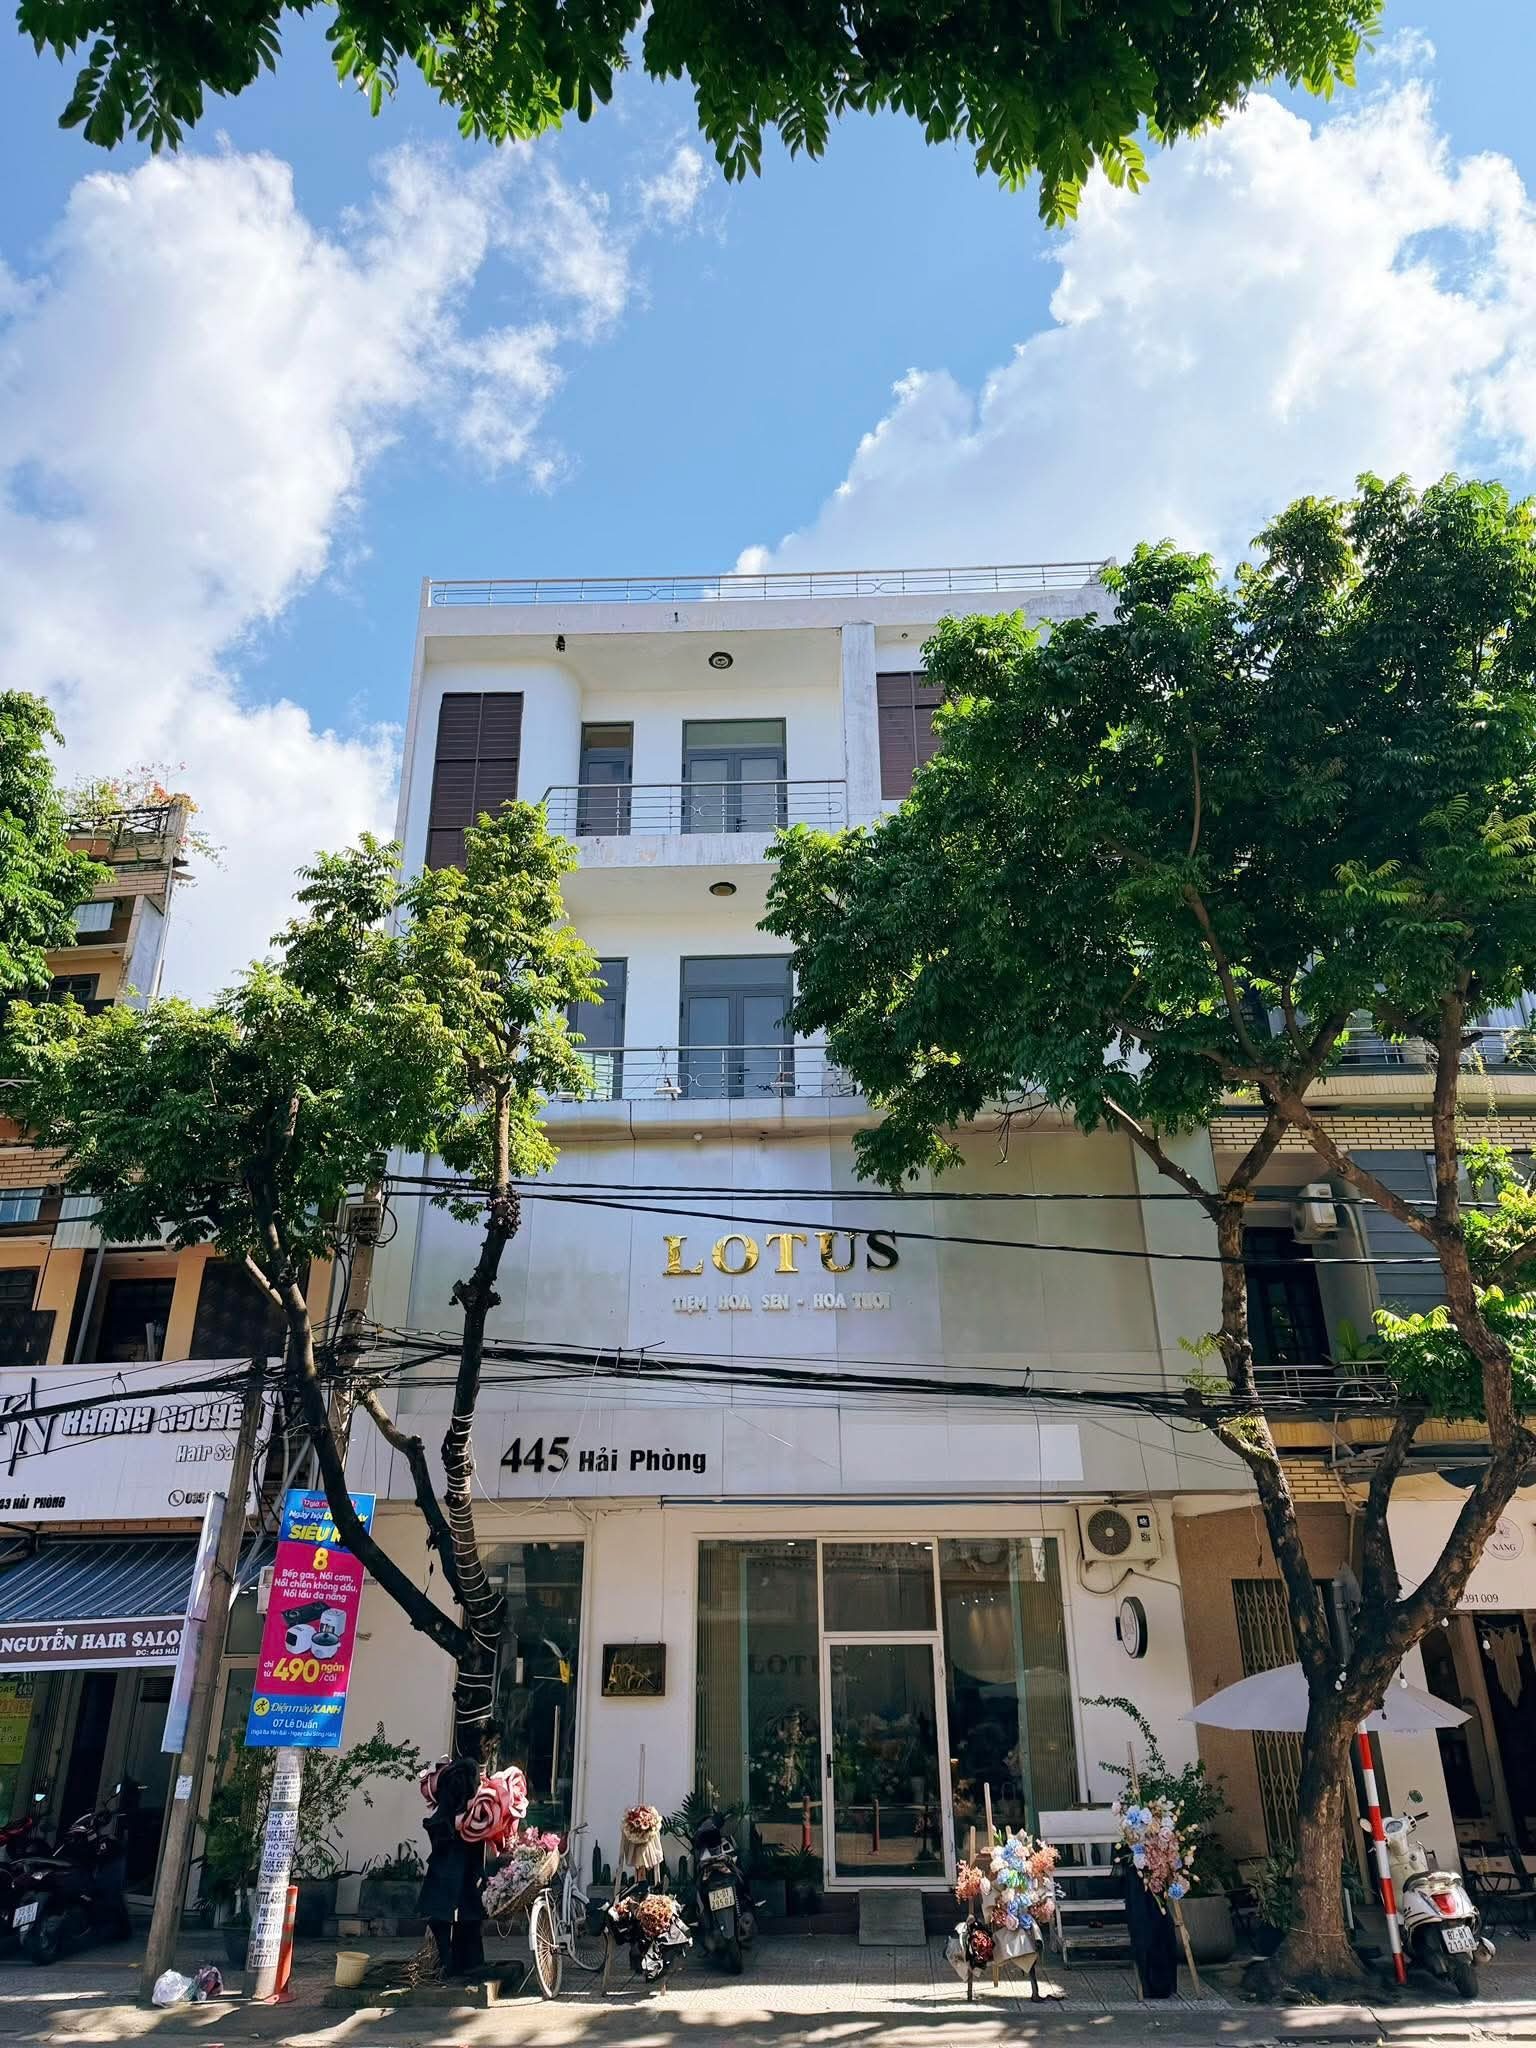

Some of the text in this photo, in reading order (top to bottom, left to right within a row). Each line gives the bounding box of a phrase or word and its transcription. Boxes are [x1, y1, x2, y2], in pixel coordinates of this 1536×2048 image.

[662, 1229, 899, 1276] LOTUS
[672, 1294, 708, 1315] TIỆM
[718, 1293, 752, 1312] HOA
[761, 1293, 790, 1312] SEN
[814, 1292, 848, 1311] HOA
[176, 1446, 212, 1463] Hair
[500, 1436, 706, 1474] 445 Hải Phòng
[12, 1494, 29, 1509] HẢI
[33, 1494, 66, 1509] PHÒNG
[289, 1510, 309, 1519] Ngày
[311, 1511, 323, 1521] hội
[288, 1521, 330, 1542] SIÊU
[313, 1547, 329, 1570] 8
[282, 1569, 298, 1580] Bếp
[300, 1572, 317, 1580] gas,
[289, 1580, 311, 1589] chiên
[313, 1581, 338, 1592] không
[313, 1591, 324, 1600] đa
[325, 1592, 347, 1603] năng
[1480, 1593, 1499, 1603] 009
[0, 1628, 184, 1653] NGUYỄN HAIR SALO
[150, 1648, 164, 1656] 443
[272, 1657, 320, 1683] 490
[311, 1704, 342, 1714] XANH
[272, 1719, 284, 1728] 07
[285, 1718, 295, 1728] Lê
